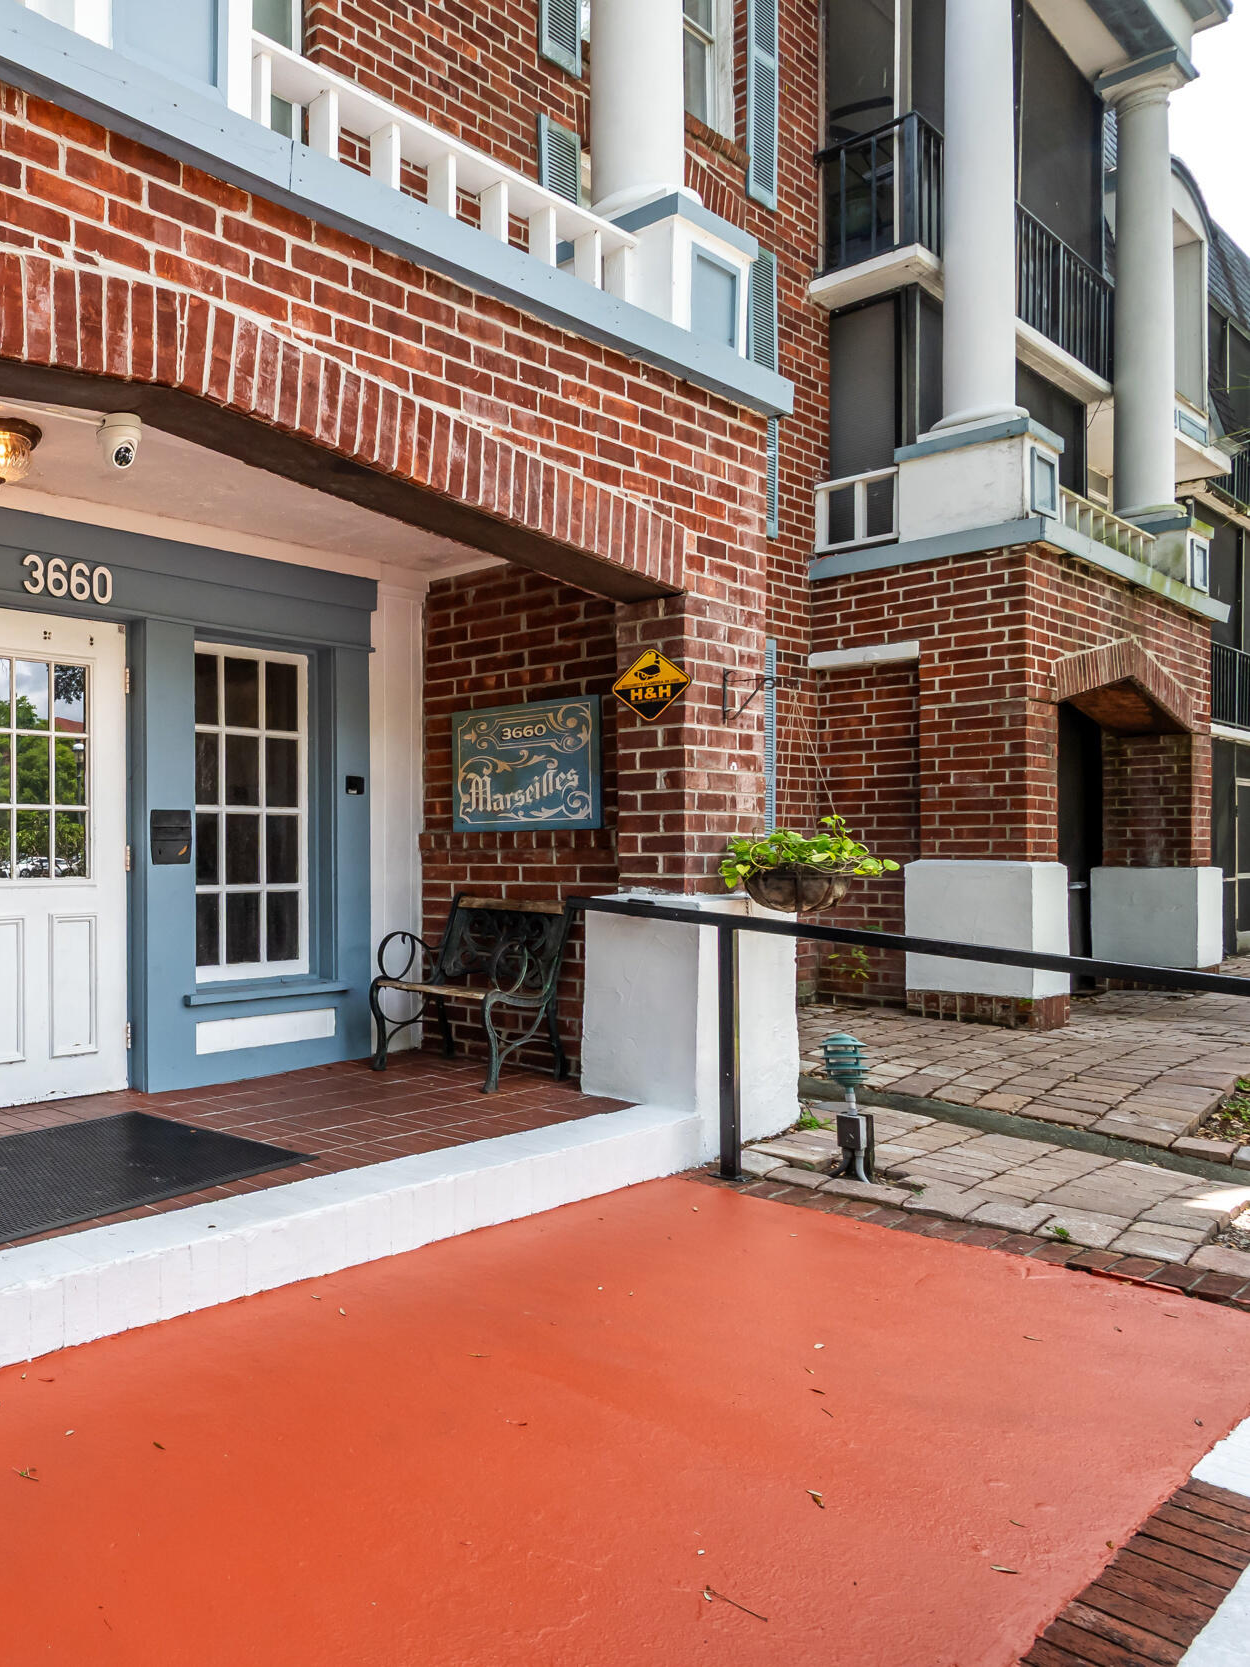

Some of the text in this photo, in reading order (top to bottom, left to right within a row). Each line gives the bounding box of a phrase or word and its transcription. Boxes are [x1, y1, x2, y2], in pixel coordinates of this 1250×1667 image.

[22, 553, 113, 605] 3660
[630, 685, 671, 701] H&H
[501, 723, 547, 741] 3660
[465, 768, 579, 813] Marseilles
